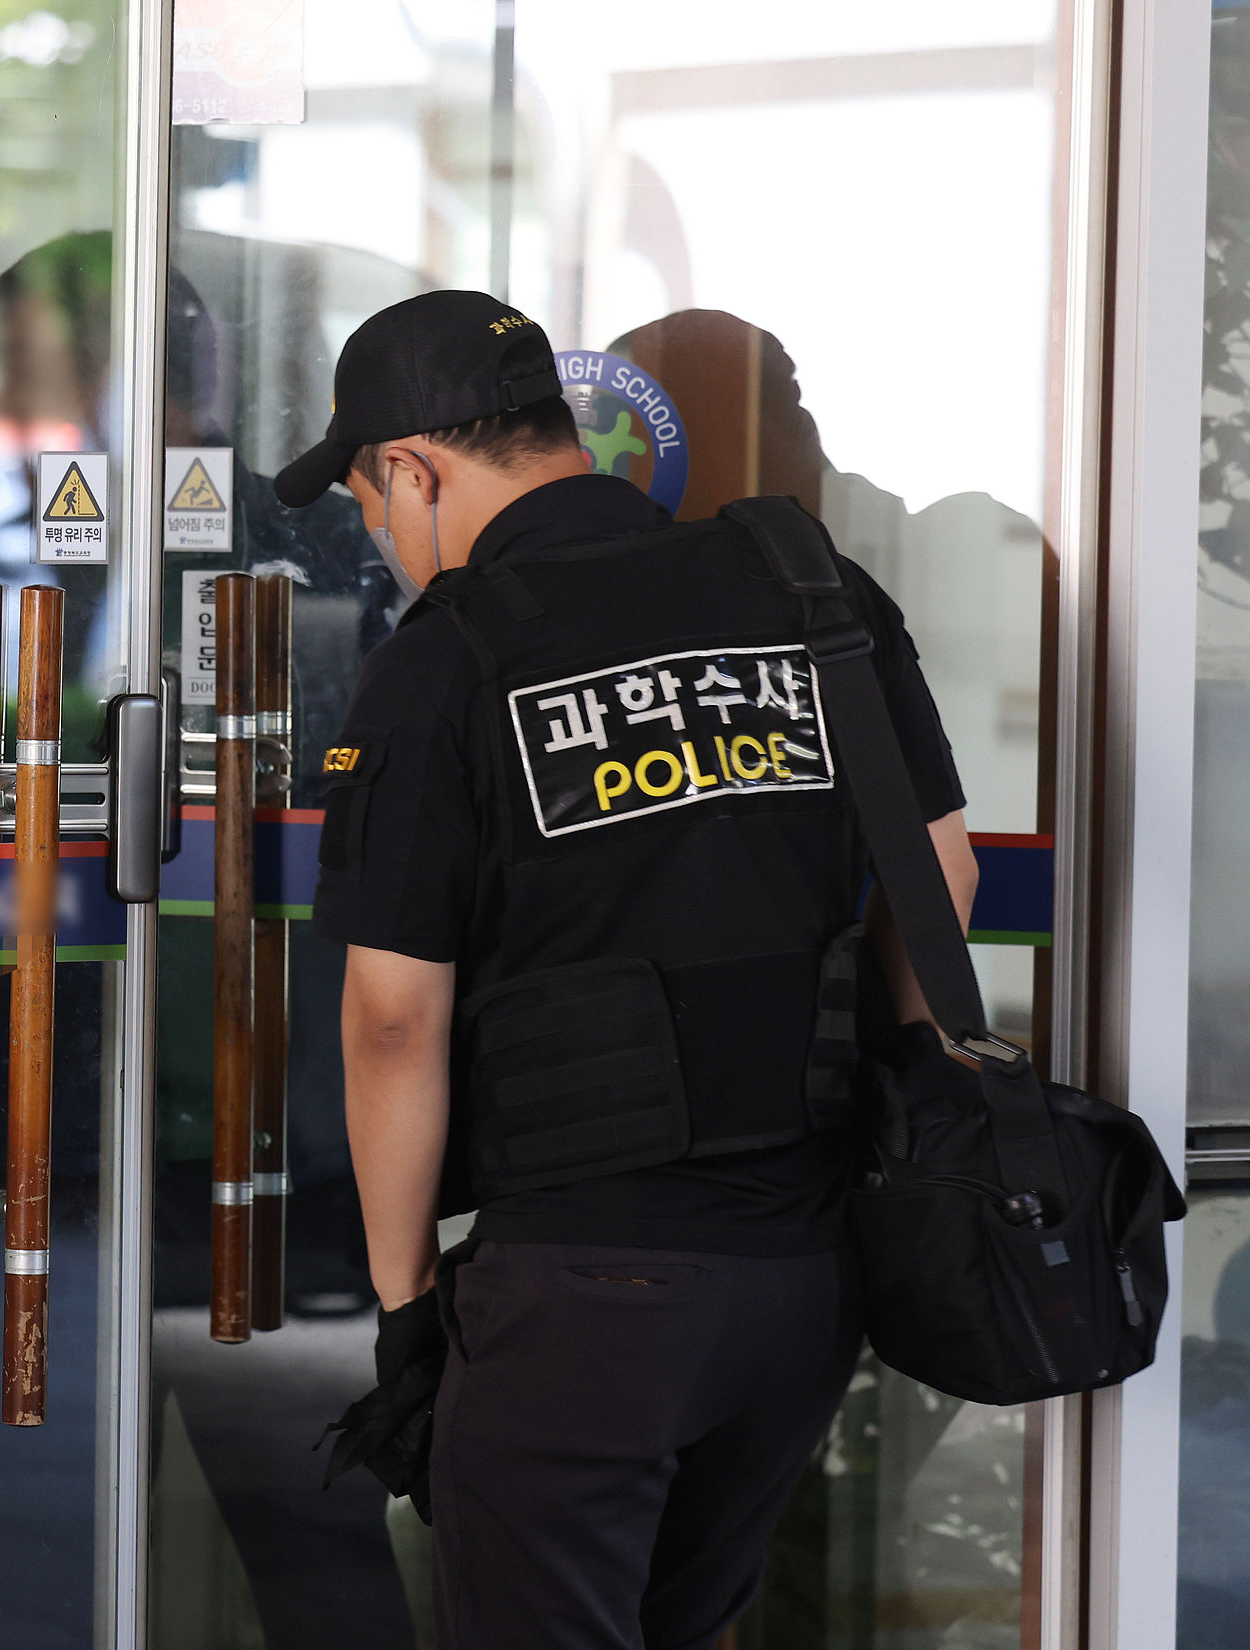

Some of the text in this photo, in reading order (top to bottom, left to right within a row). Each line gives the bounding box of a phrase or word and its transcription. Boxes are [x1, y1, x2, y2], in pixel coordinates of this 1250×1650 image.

[559, 356, 680, 458] IGH SCHOOL
[45, 527, 102, 543] 투명 유리 주의
[168, 517, 226, 532] 넘어짐 주의
[191, 681, 216, 693] DOO
[537, 659, 799, 753] 과학수사
[593, 732, 792, 811] POLICE
